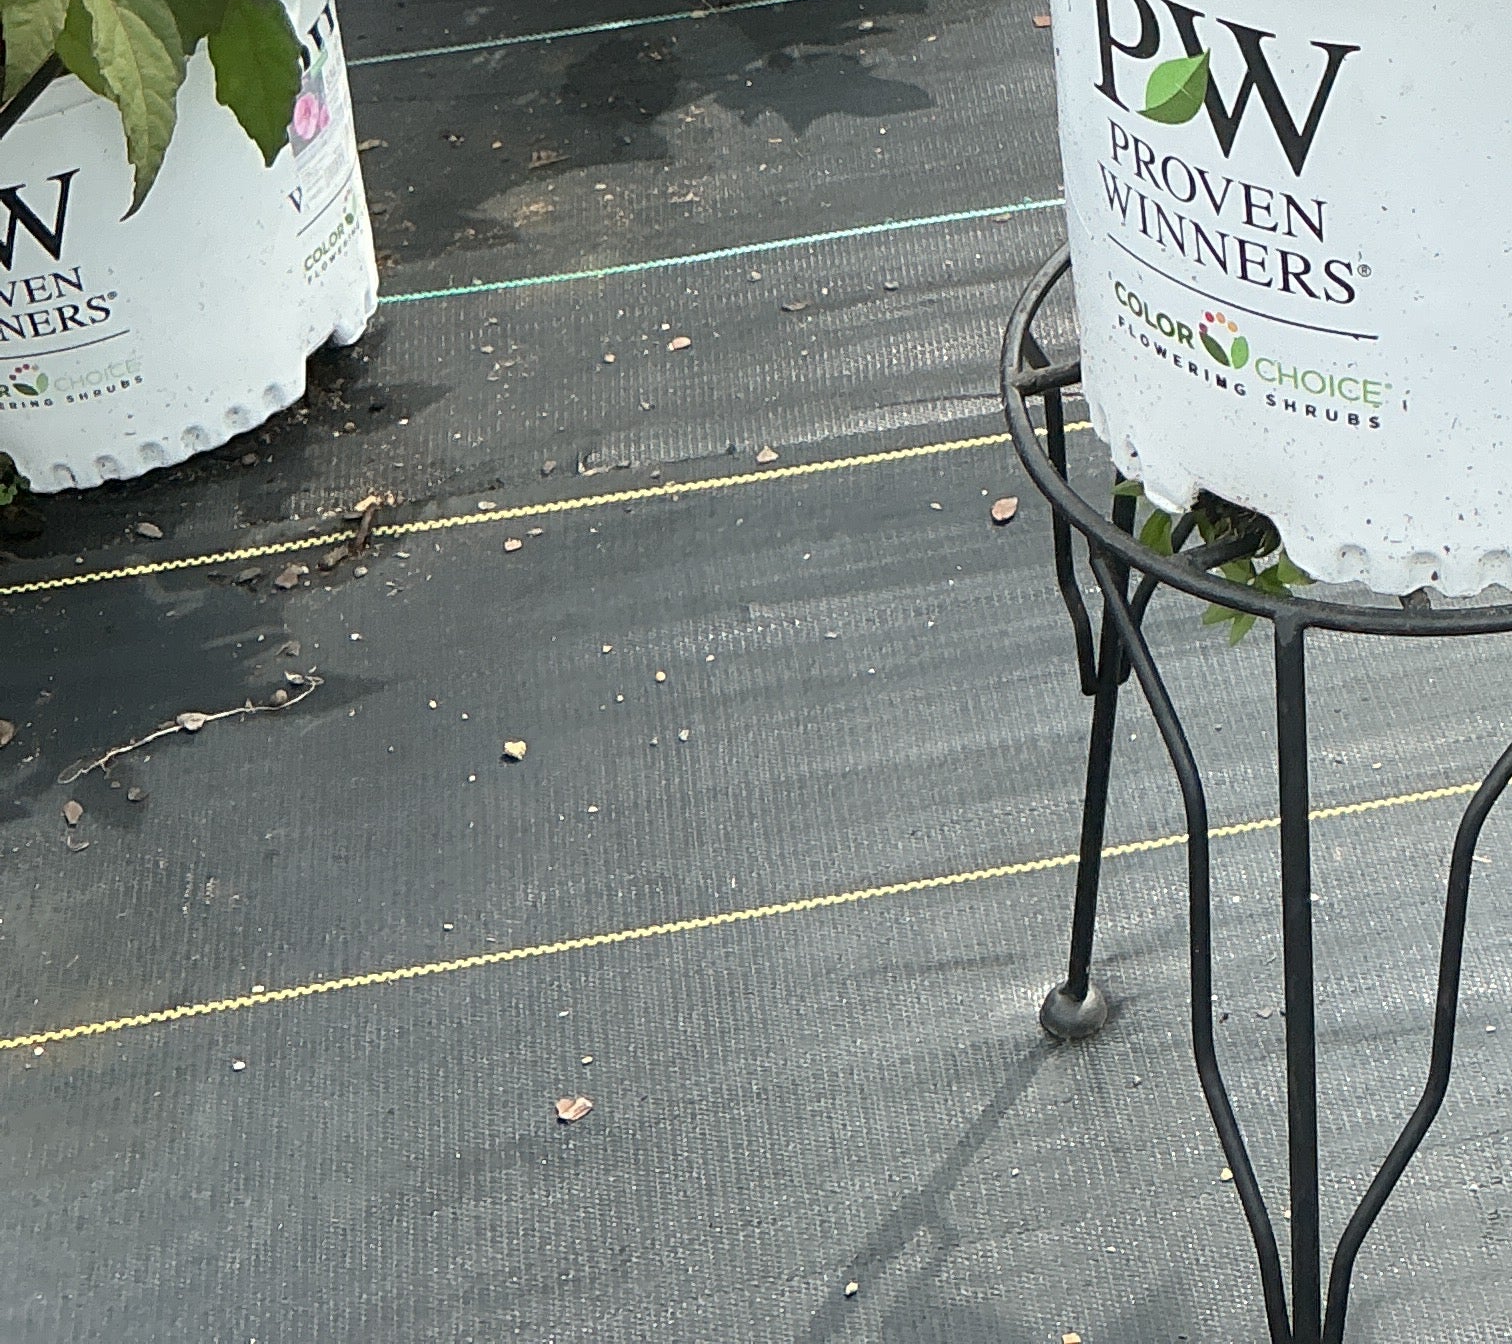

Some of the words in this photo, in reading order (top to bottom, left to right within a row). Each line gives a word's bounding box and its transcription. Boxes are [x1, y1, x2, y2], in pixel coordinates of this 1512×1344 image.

[1107, 117, 1328, 243] PROVEN
[304, 222, 345, 272] COLOR
[1114, 281, 1194, 349] COLOR
[66, 374, 144, 404] SHRUBS
[1118, 314, 1246, 396] FLOWERING
[1266, 394, 1380, 429] SHRUBS
